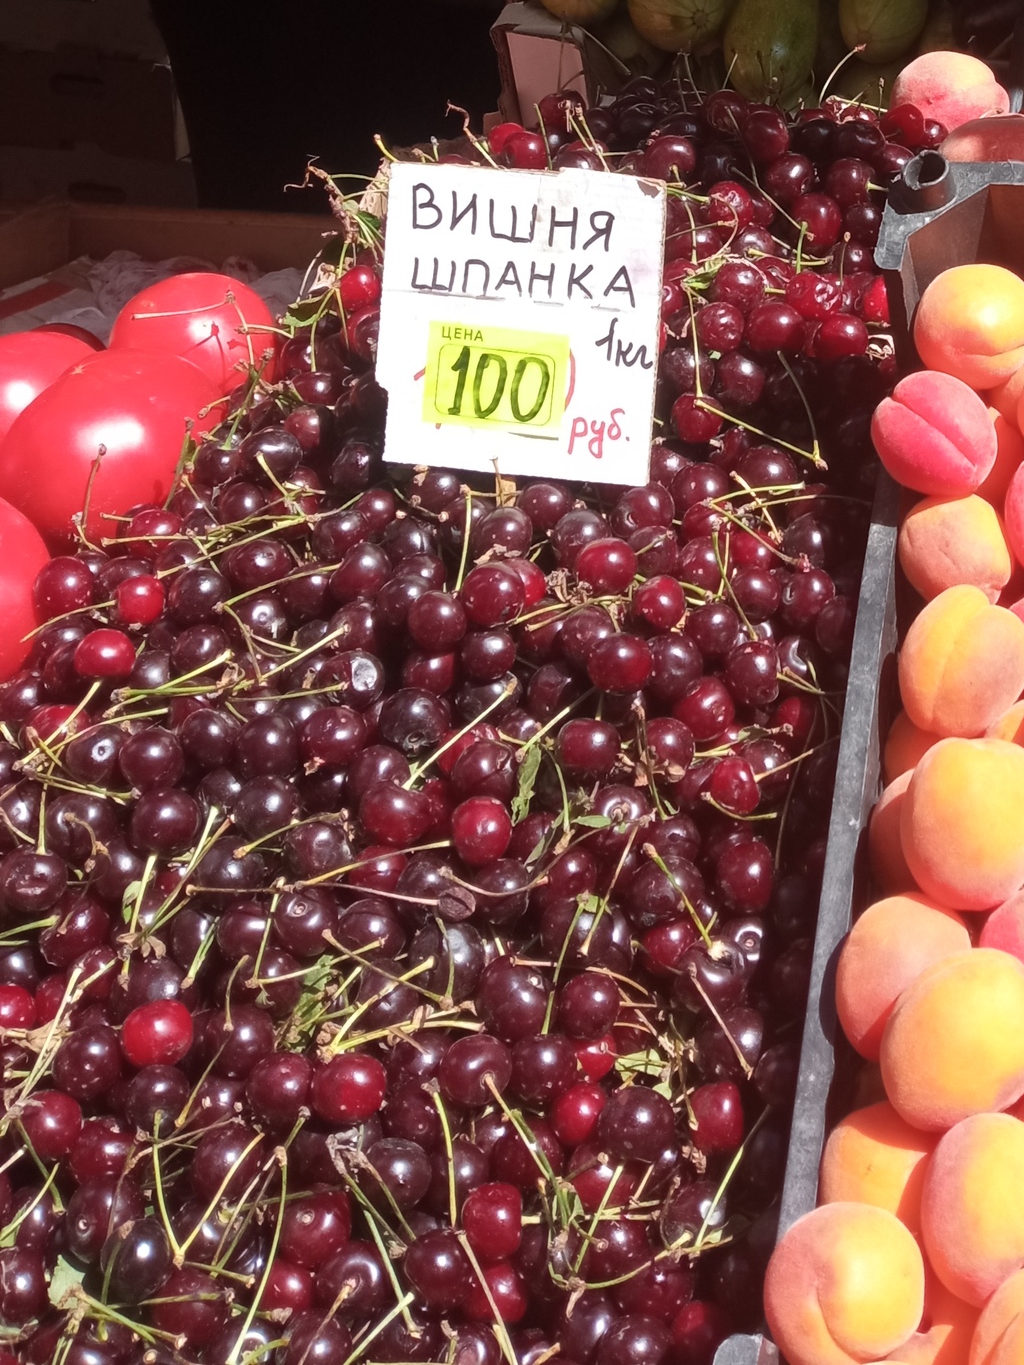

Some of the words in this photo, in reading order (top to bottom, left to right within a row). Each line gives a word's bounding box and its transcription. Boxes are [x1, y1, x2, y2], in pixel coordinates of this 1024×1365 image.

[412, 182, 616, 252] ВИШНЯ
[410, 256, 636, 308] ШПАНКА
[441, 325, 484, 342] ЦЕНА
[595, 317, 654, 370] 1кг
[446, 345, 551, 423] 100
[567, 408, 631, 459] руб.
